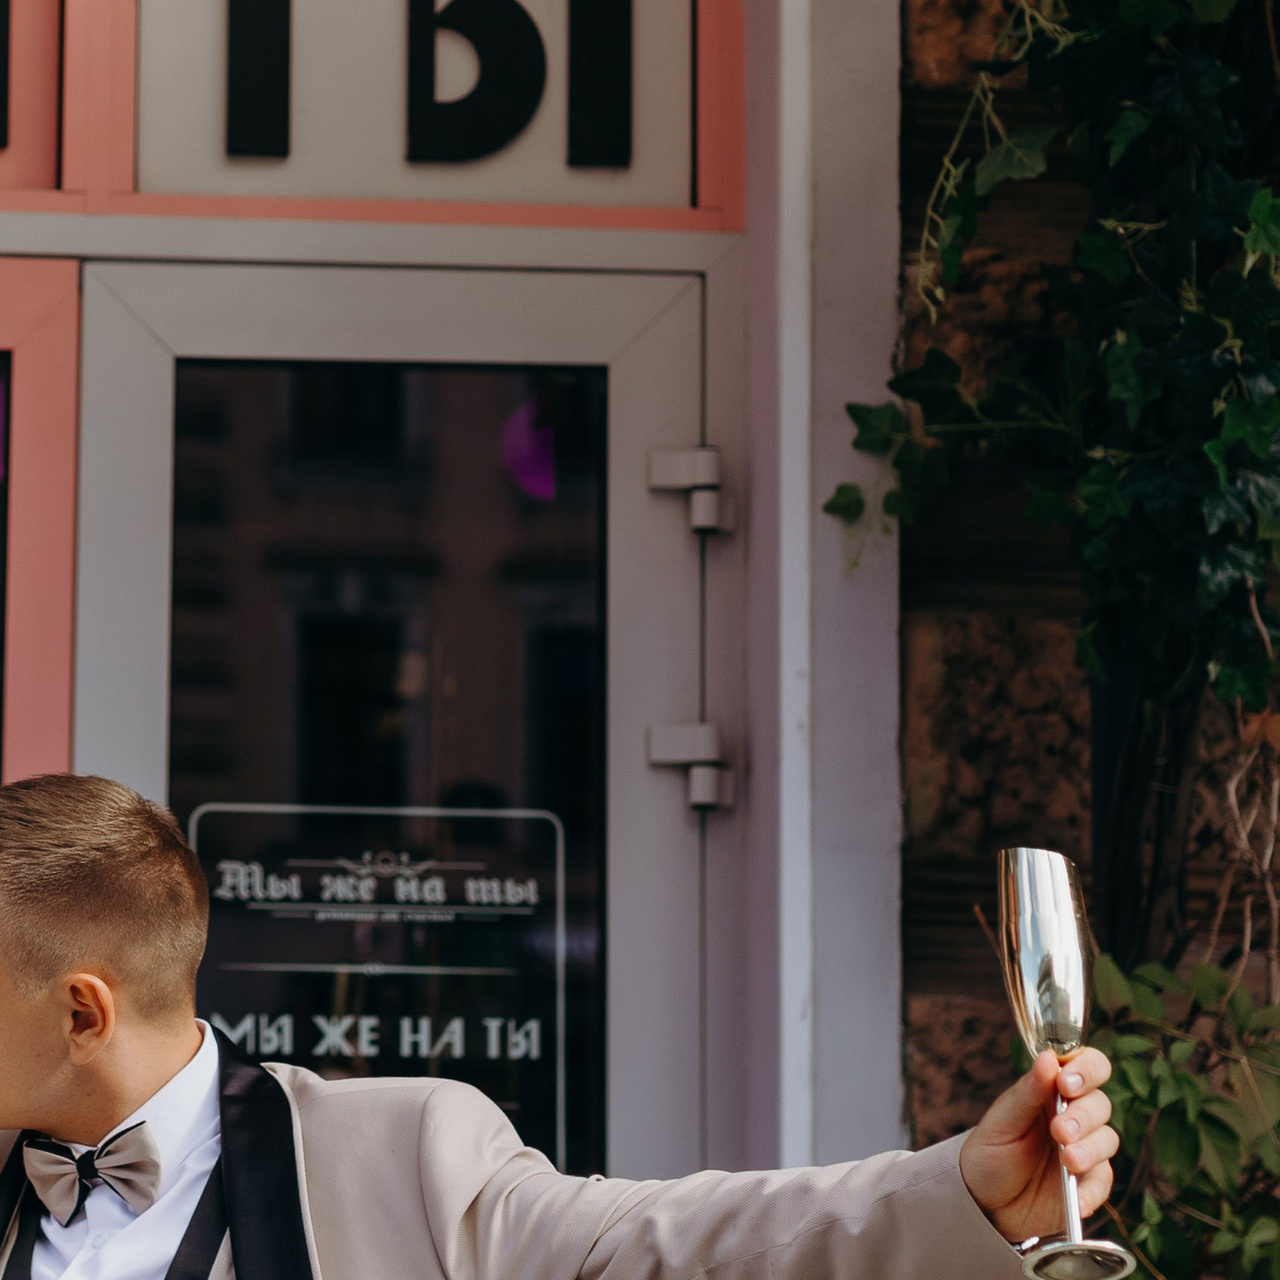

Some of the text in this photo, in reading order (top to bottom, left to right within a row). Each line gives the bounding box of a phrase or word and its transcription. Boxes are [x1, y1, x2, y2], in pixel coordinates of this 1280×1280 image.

[213, 860, 540, 905] Мы же на ты
[211, 1012, 541, 1060] МЫ ЖЕ НА ТЫ
